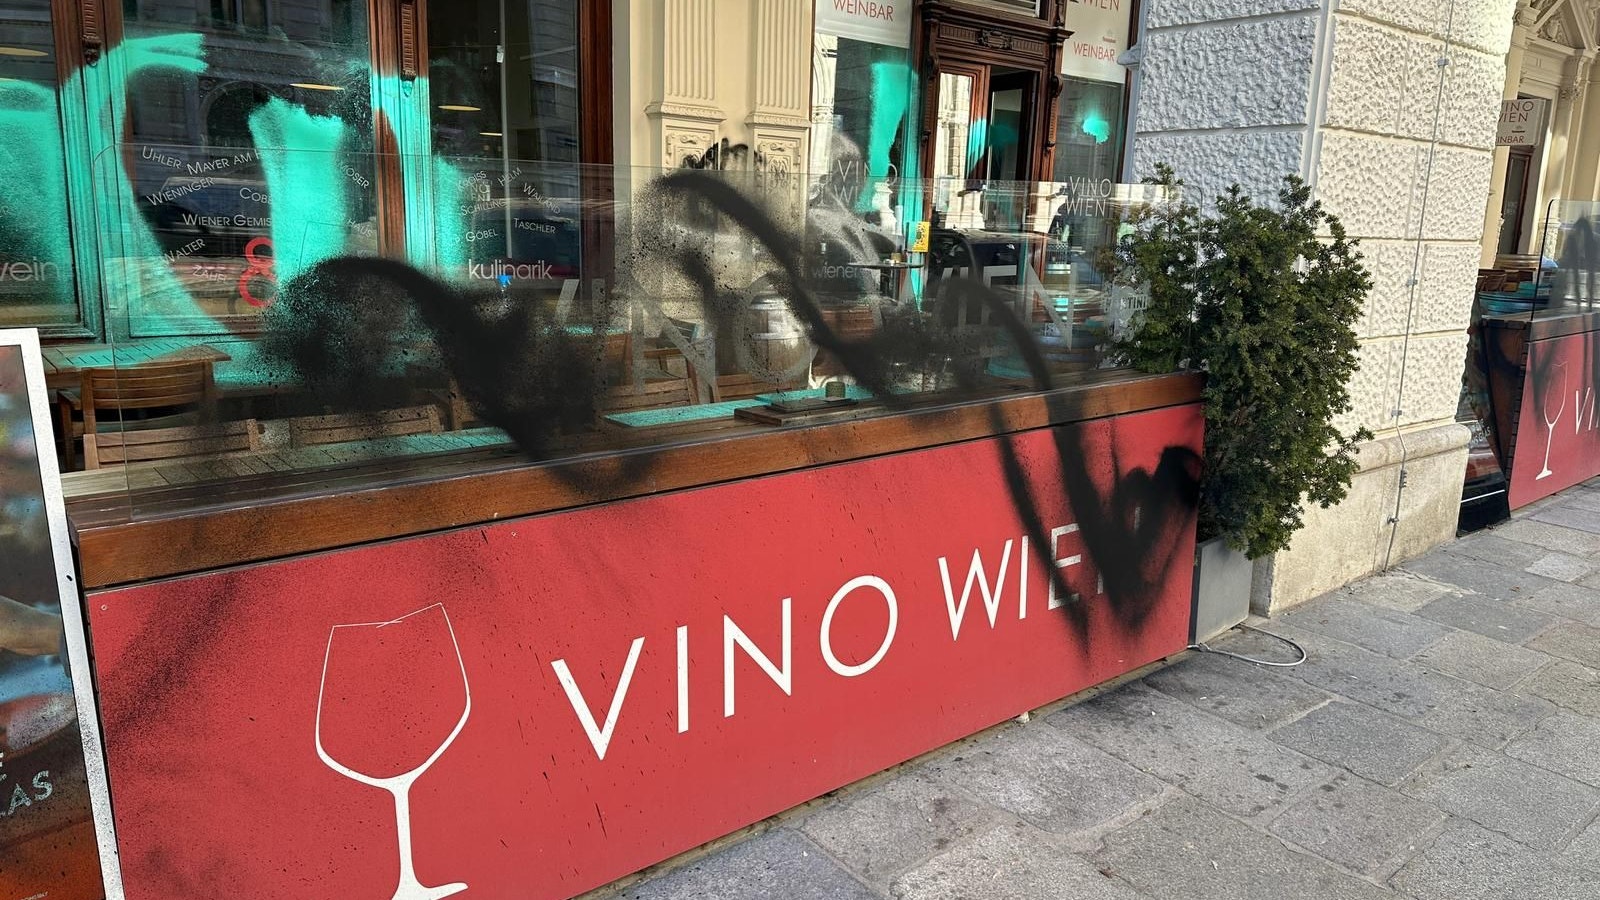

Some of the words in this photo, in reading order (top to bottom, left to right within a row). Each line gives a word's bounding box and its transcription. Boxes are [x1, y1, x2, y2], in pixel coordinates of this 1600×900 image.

[834, 0, 893, 21] WEINBAR
[1073, 41, 1115, 62] WEINBAR
[142, 145, 182, 169] UHLER
[186, 158, 230, 176] MAYER
[233, 152, 252, 166] AM
[146, 176, 216, 207] WIENINGER
[1068, 175, 1112, 198] VINO
[1063, 198, 1106, 217] WIEN
[182, 213, 231, 228] WIENER
[513, 217, 557, 235] TASCHLER
[161, 238, 206, 265] WALTER
[468, 258, 553, 281] kulinarik
[550, 574, 899, 761] VINO
[938, 506, 1142, 642] WIE
